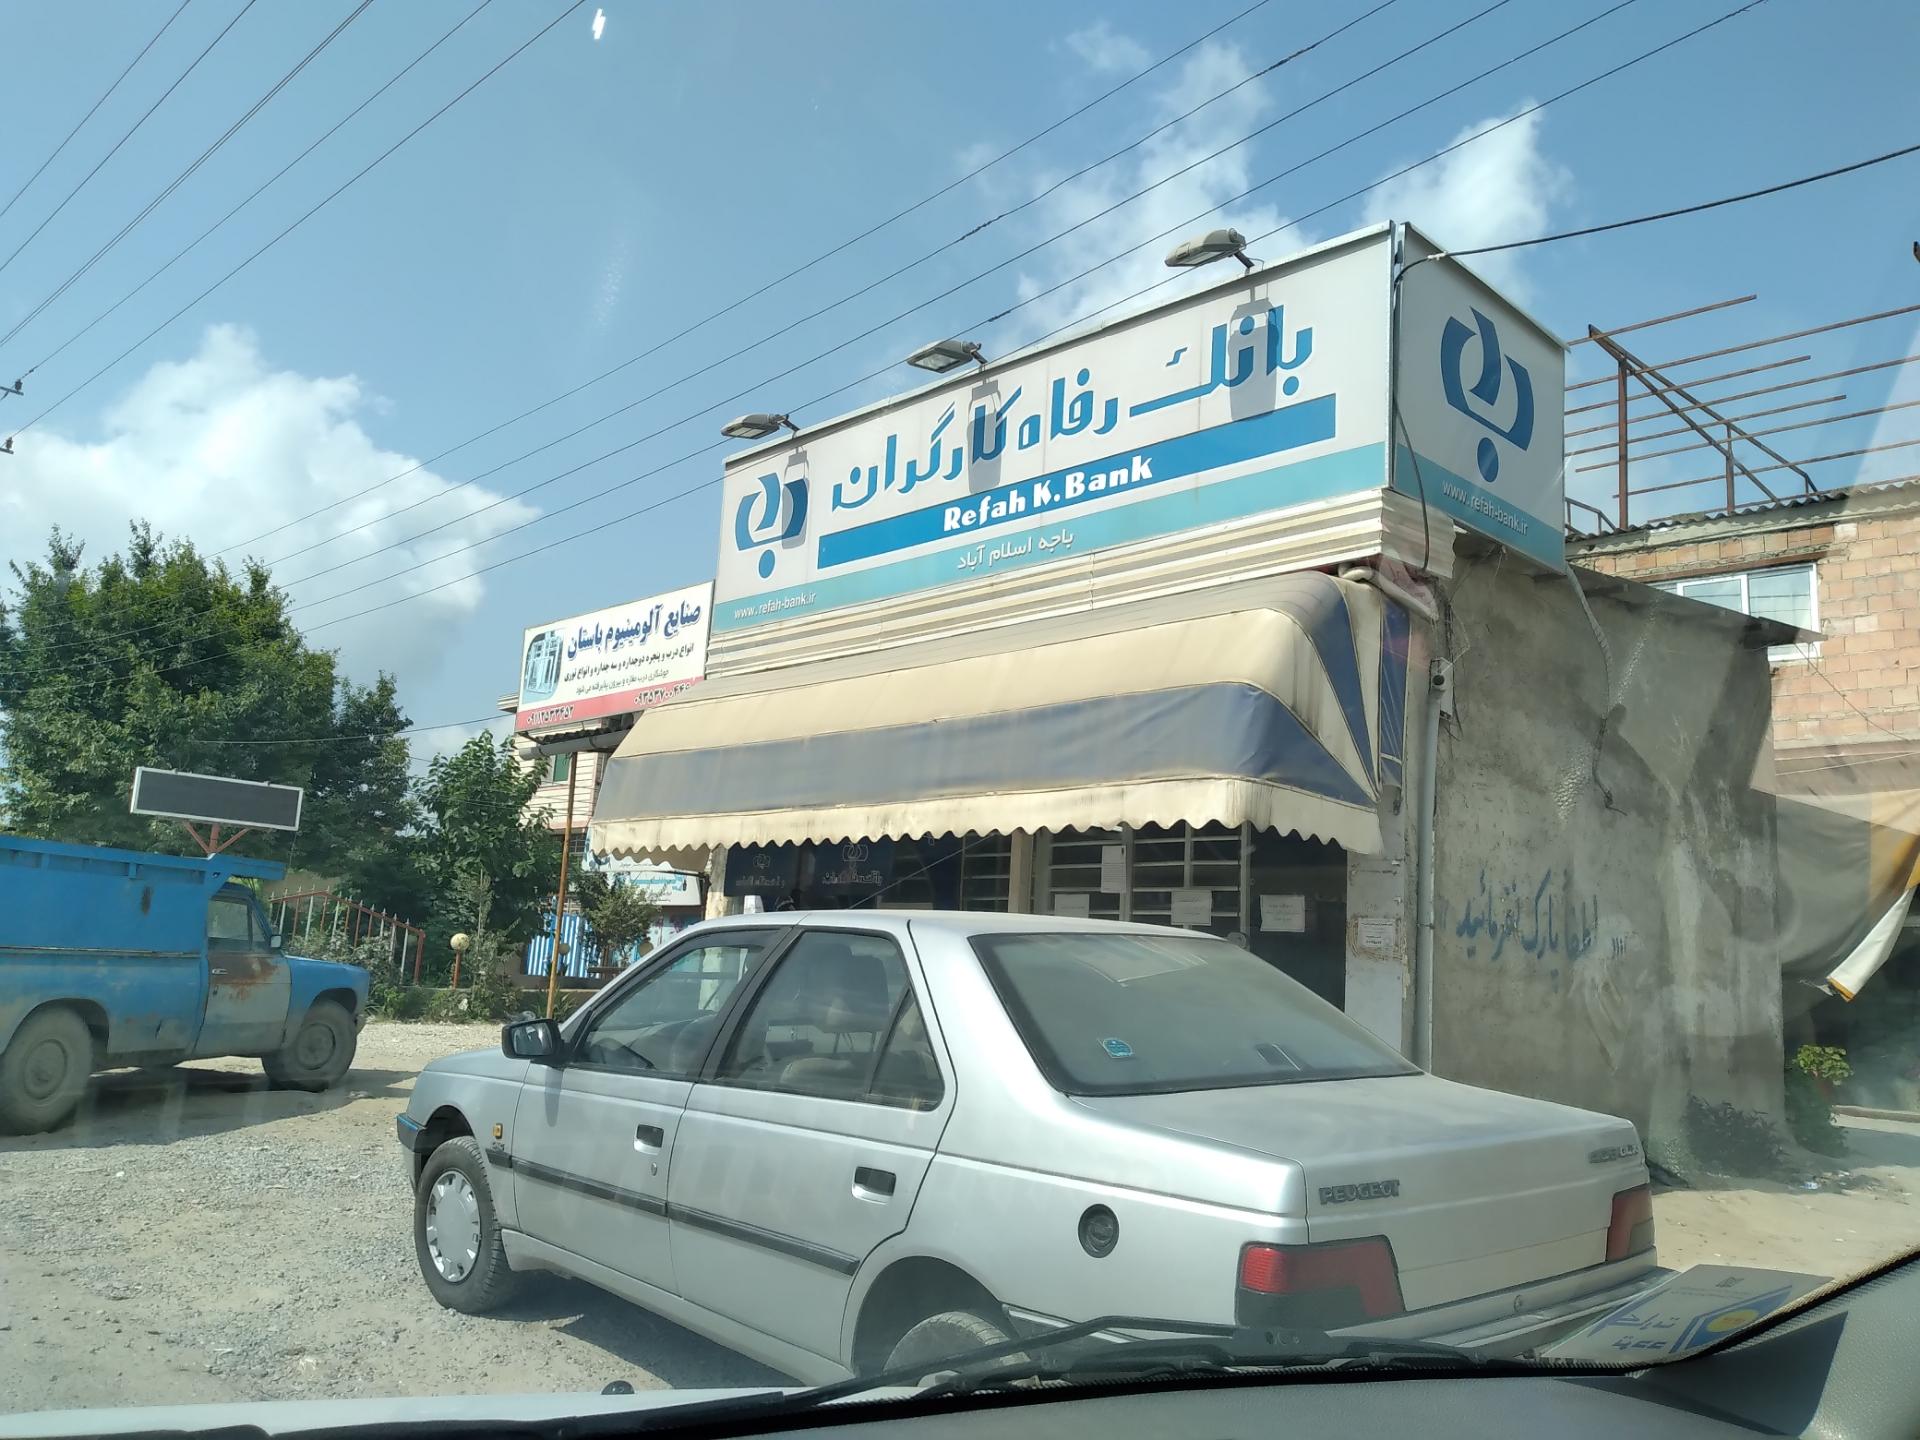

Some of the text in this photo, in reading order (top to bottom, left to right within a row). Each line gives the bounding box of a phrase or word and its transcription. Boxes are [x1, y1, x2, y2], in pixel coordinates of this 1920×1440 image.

[832, 304, 1313, 511] بانک رفاه کارگران
[943, 489, 1027, 532] Refah
[957, 528, 1075, 571] باجه اسلام آباد
[664, 600, 702, 637] صنایع
[567, 621, 604, 660] باستان
[1318, 1179, 1400, 1205] PEUGEOT
